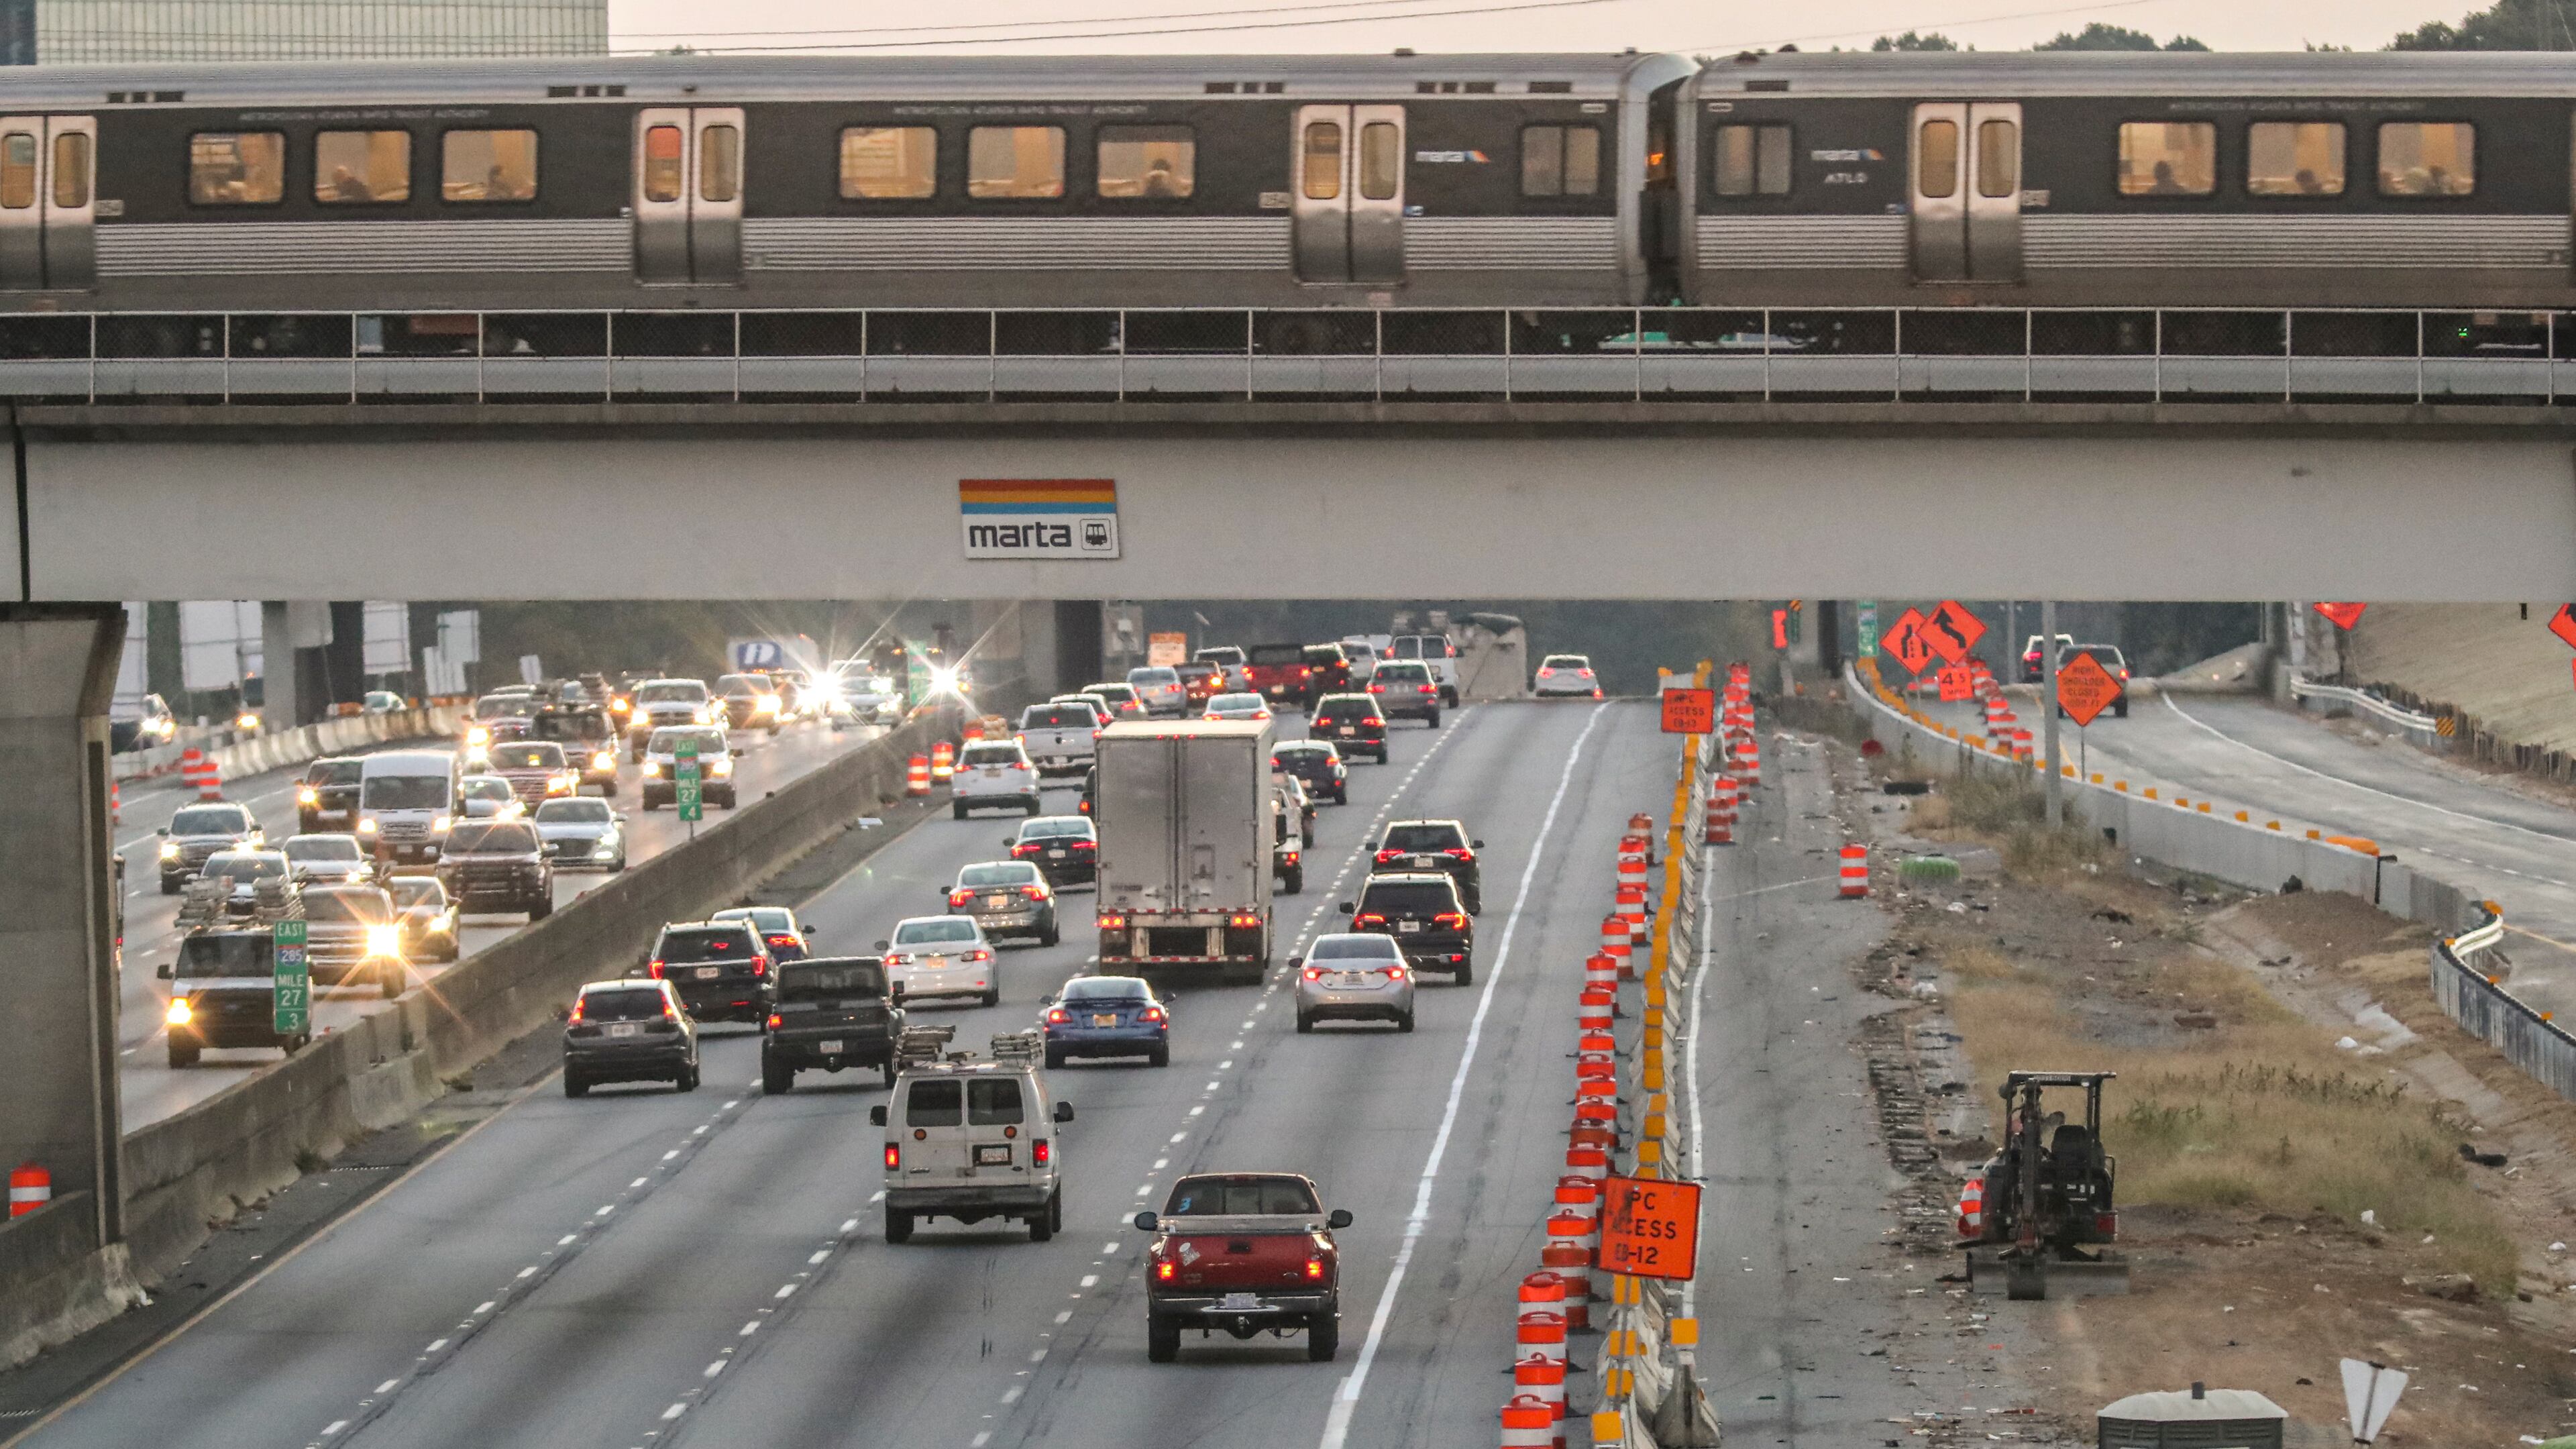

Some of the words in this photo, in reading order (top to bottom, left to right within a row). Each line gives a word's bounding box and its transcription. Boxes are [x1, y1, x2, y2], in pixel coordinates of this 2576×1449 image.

[969, 521, 1071, 547] marta
[682, 789, 697, 802] 27
[278, 922, 303, 937] EAST
[282, 950, 303, 962] 285
[278, 974, 304, 988] MILE
[280, 989, 302, 1006] 27
